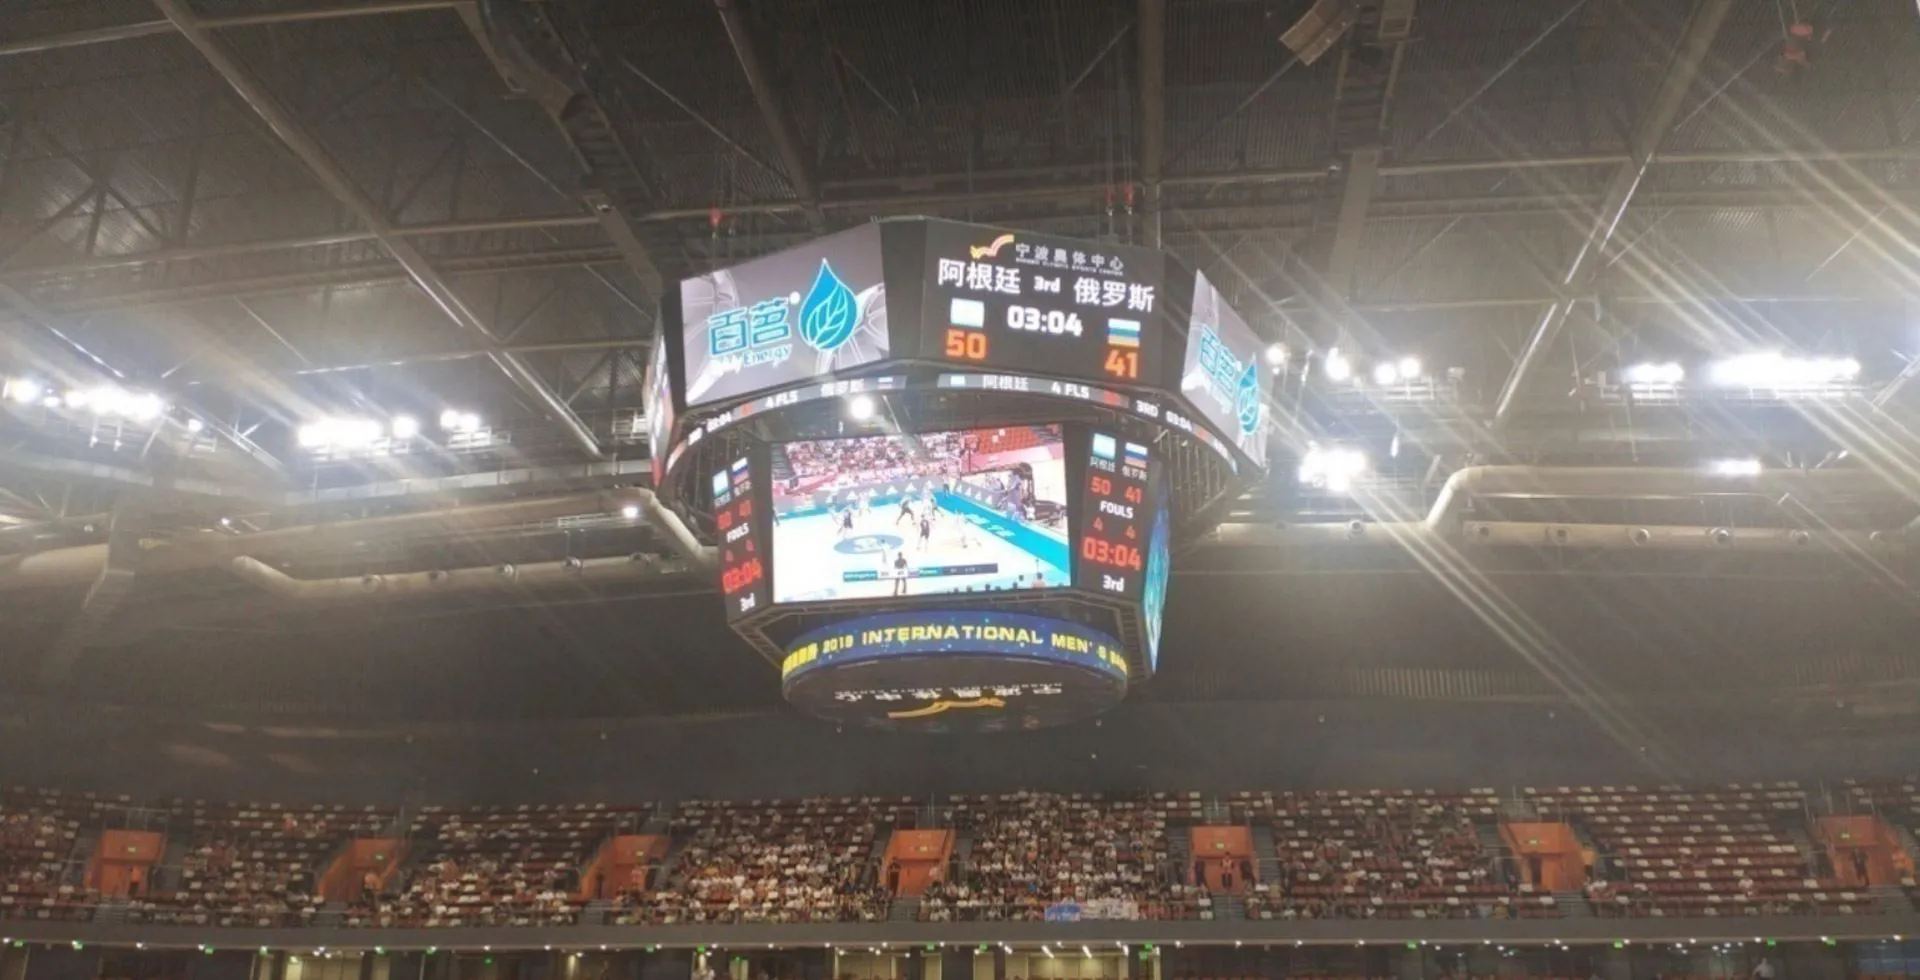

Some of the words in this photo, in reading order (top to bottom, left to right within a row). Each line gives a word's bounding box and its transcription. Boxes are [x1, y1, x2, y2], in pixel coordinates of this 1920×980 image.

[938, 258, 1021, 295] 阿根廷
[1033, 276, 1061, 293] 3rd
[1074, 276, 1155, 313] 俄罗斯
[1006, 305, 1084, 337] 03:04
[945, 329, 987, 360] 50
[1103, 349, 1138, 379] 41
[981, 375, 1029, 391] 阿根廷
[1050, 381, 1061, 394] 4
[1064, 383, 1090, 400] FLS
[775, 390, 798, 407] FLS
[1089, 476, 1111, 495] 50
[1124, 485, 1143, 504] 41
[1100, 500, 1134, 519] FOULS
[726, 522, 750, 543] FOULS
[1093, 517, 1103, 531] 4
[1125, 524, 1136, 540] 4
[1082, 536, 1142, 572] 03:04
[722, 557, 763, 593] 03:04
[1103, 575, 1125, 593] 3rd
[862, 624, 1044, 646] INTERNATIONAL
